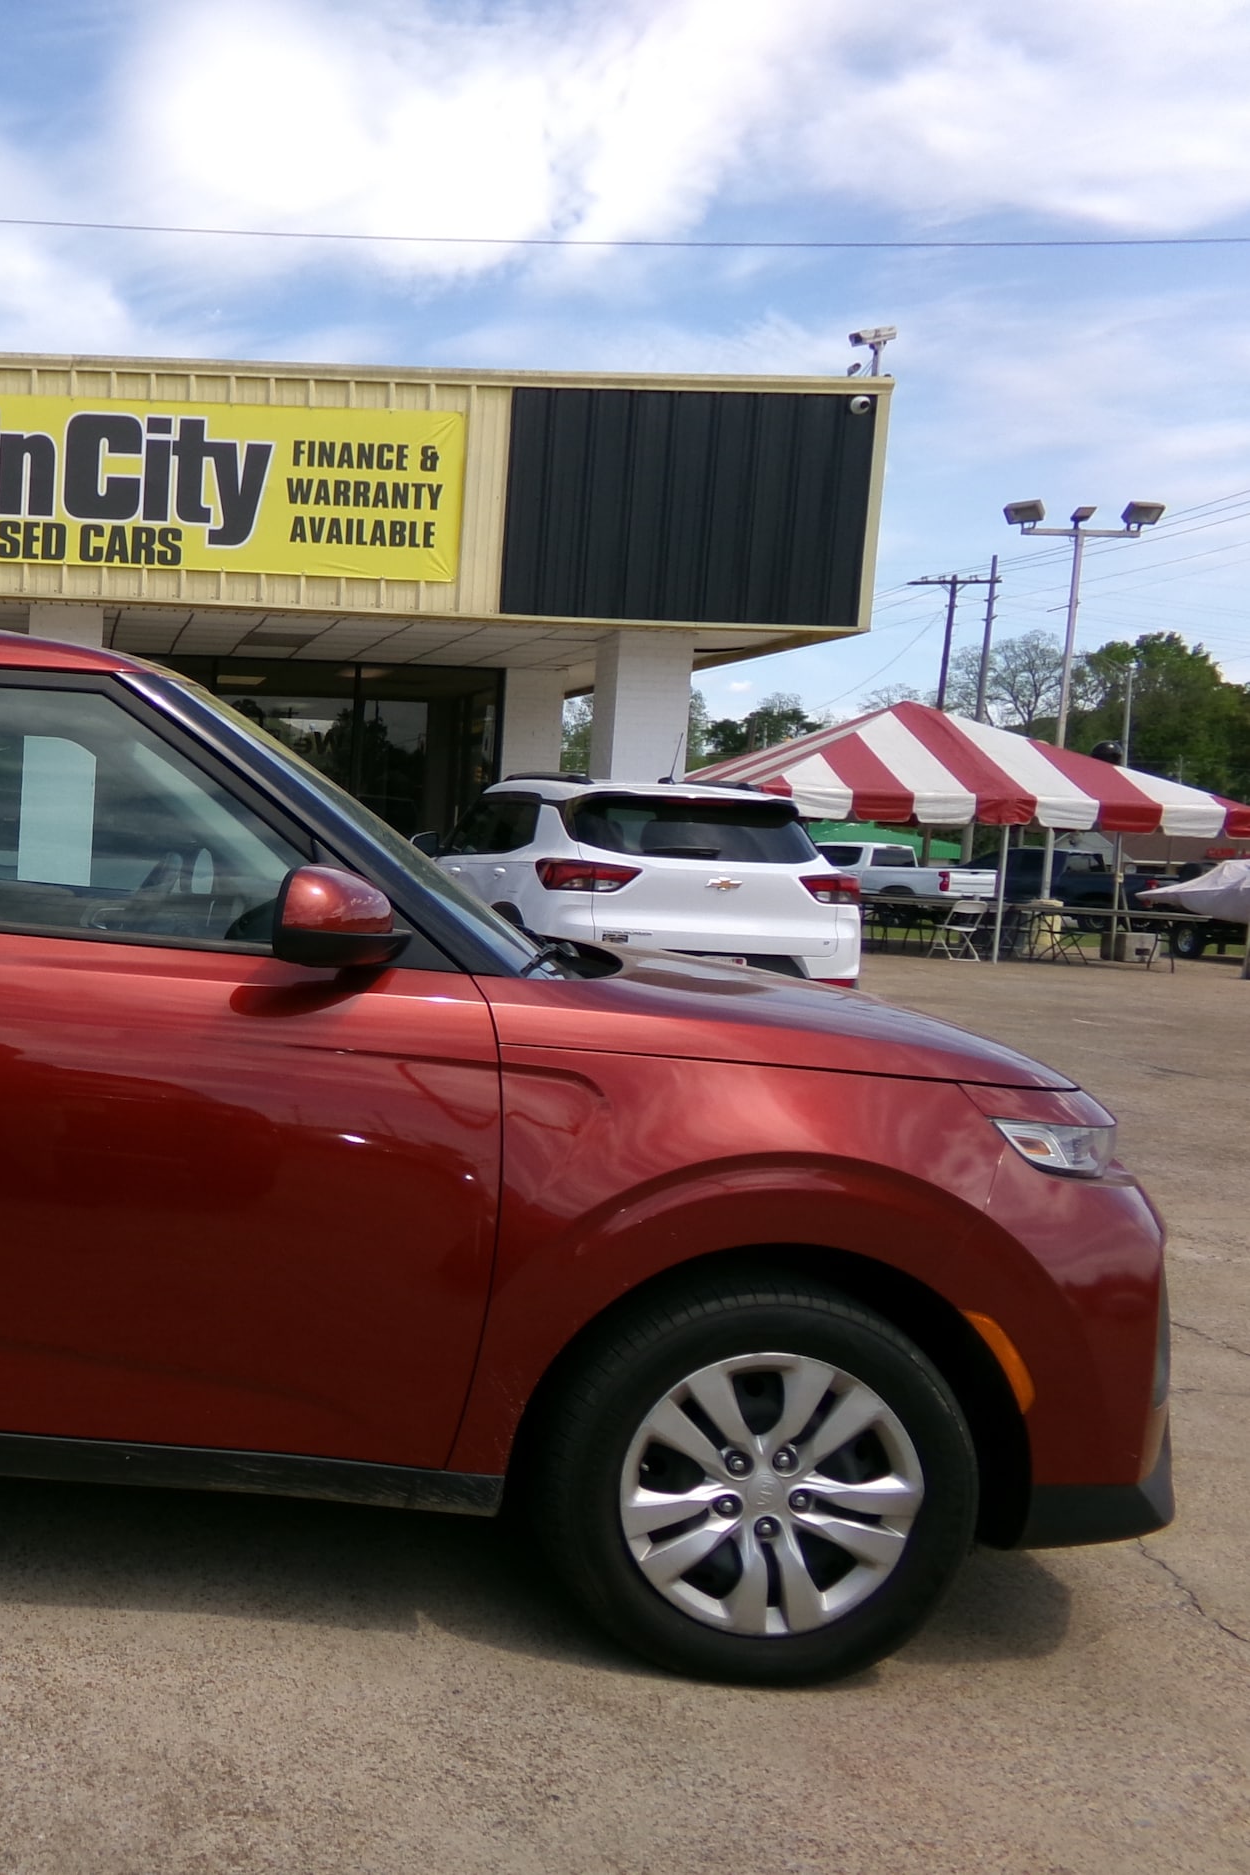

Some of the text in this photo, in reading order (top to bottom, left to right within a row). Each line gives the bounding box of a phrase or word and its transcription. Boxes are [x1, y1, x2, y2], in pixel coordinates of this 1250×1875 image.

[292, 440, 440, 472] FINANCE &
[286, 477, 443, 511] WARRANTY
[79, 523, 183, 566] CARS
[289, 516, 435, 549] AVAILABLE
